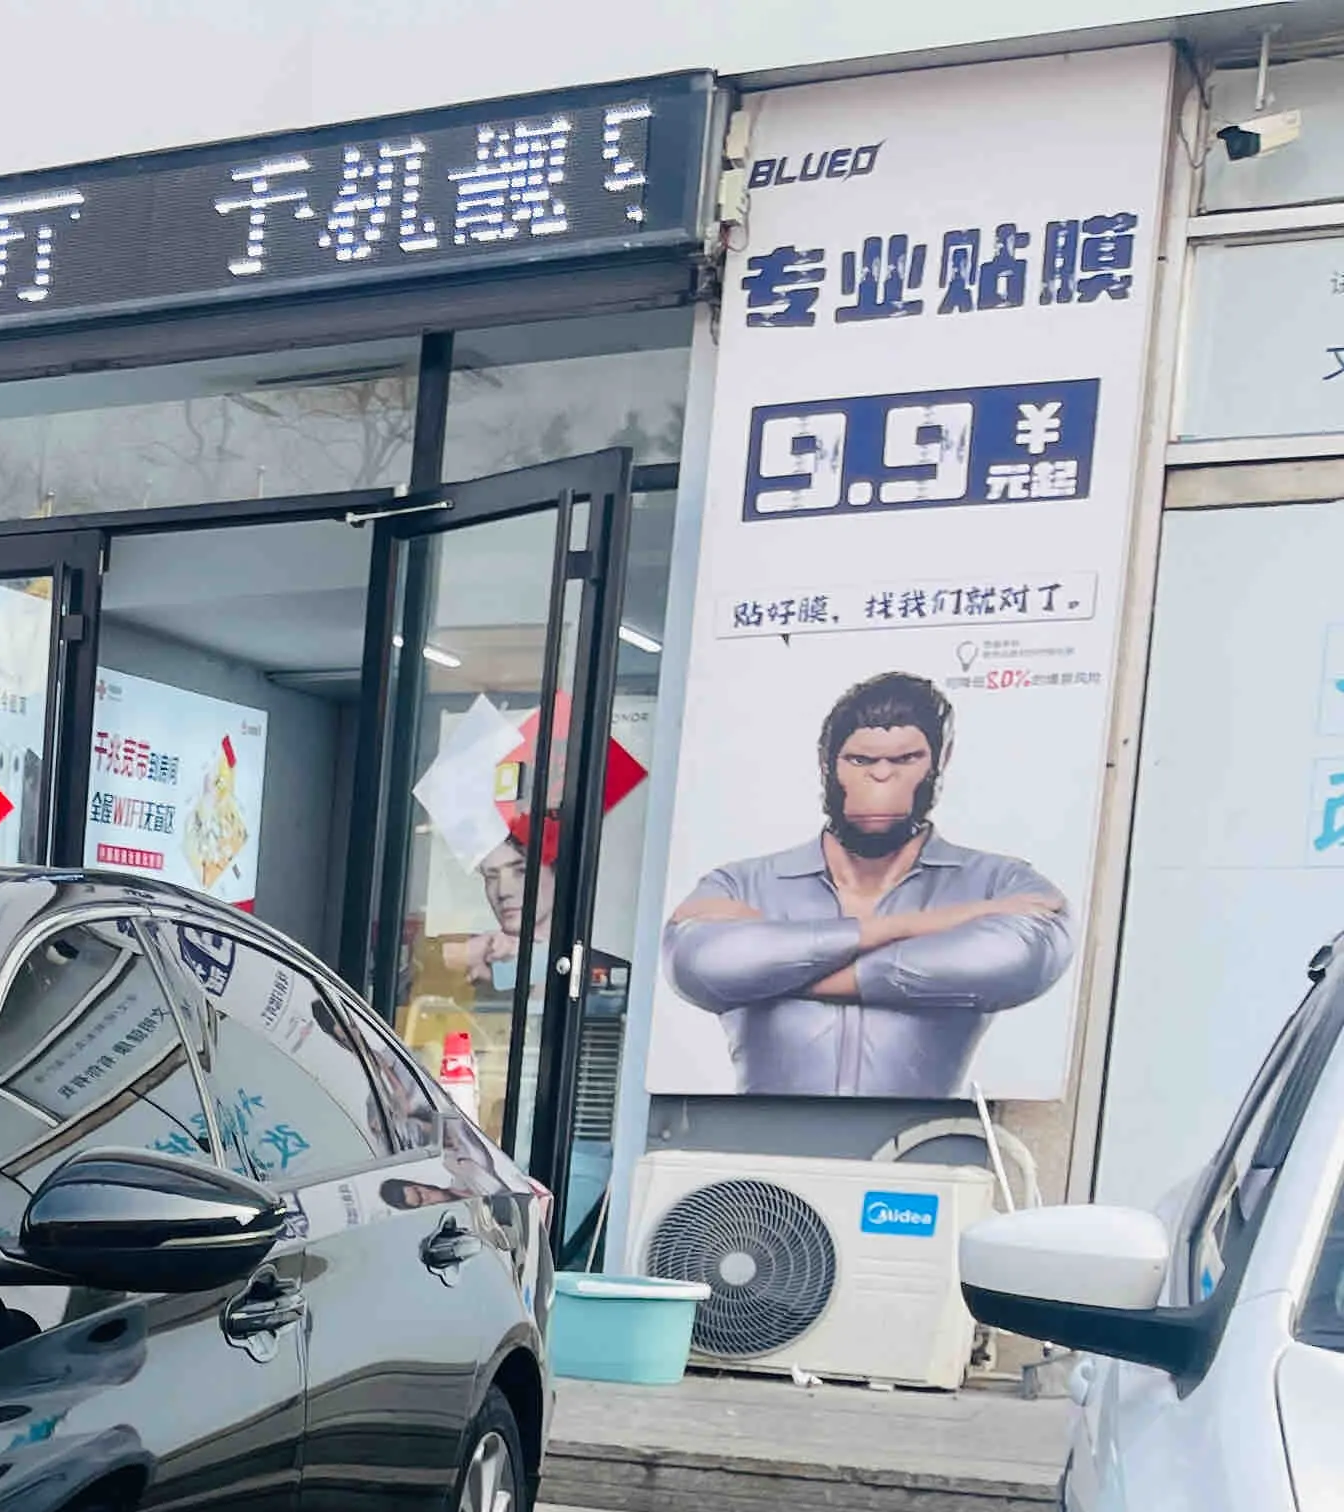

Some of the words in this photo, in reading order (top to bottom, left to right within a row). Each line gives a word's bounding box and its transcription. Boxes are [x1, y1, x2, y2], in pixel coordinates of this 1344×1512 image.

[741, 212, 1138, 328] 专业贴膜
[755, 402, 974, 514] 9.9
[870, 1203, 933, 1225] Midea
